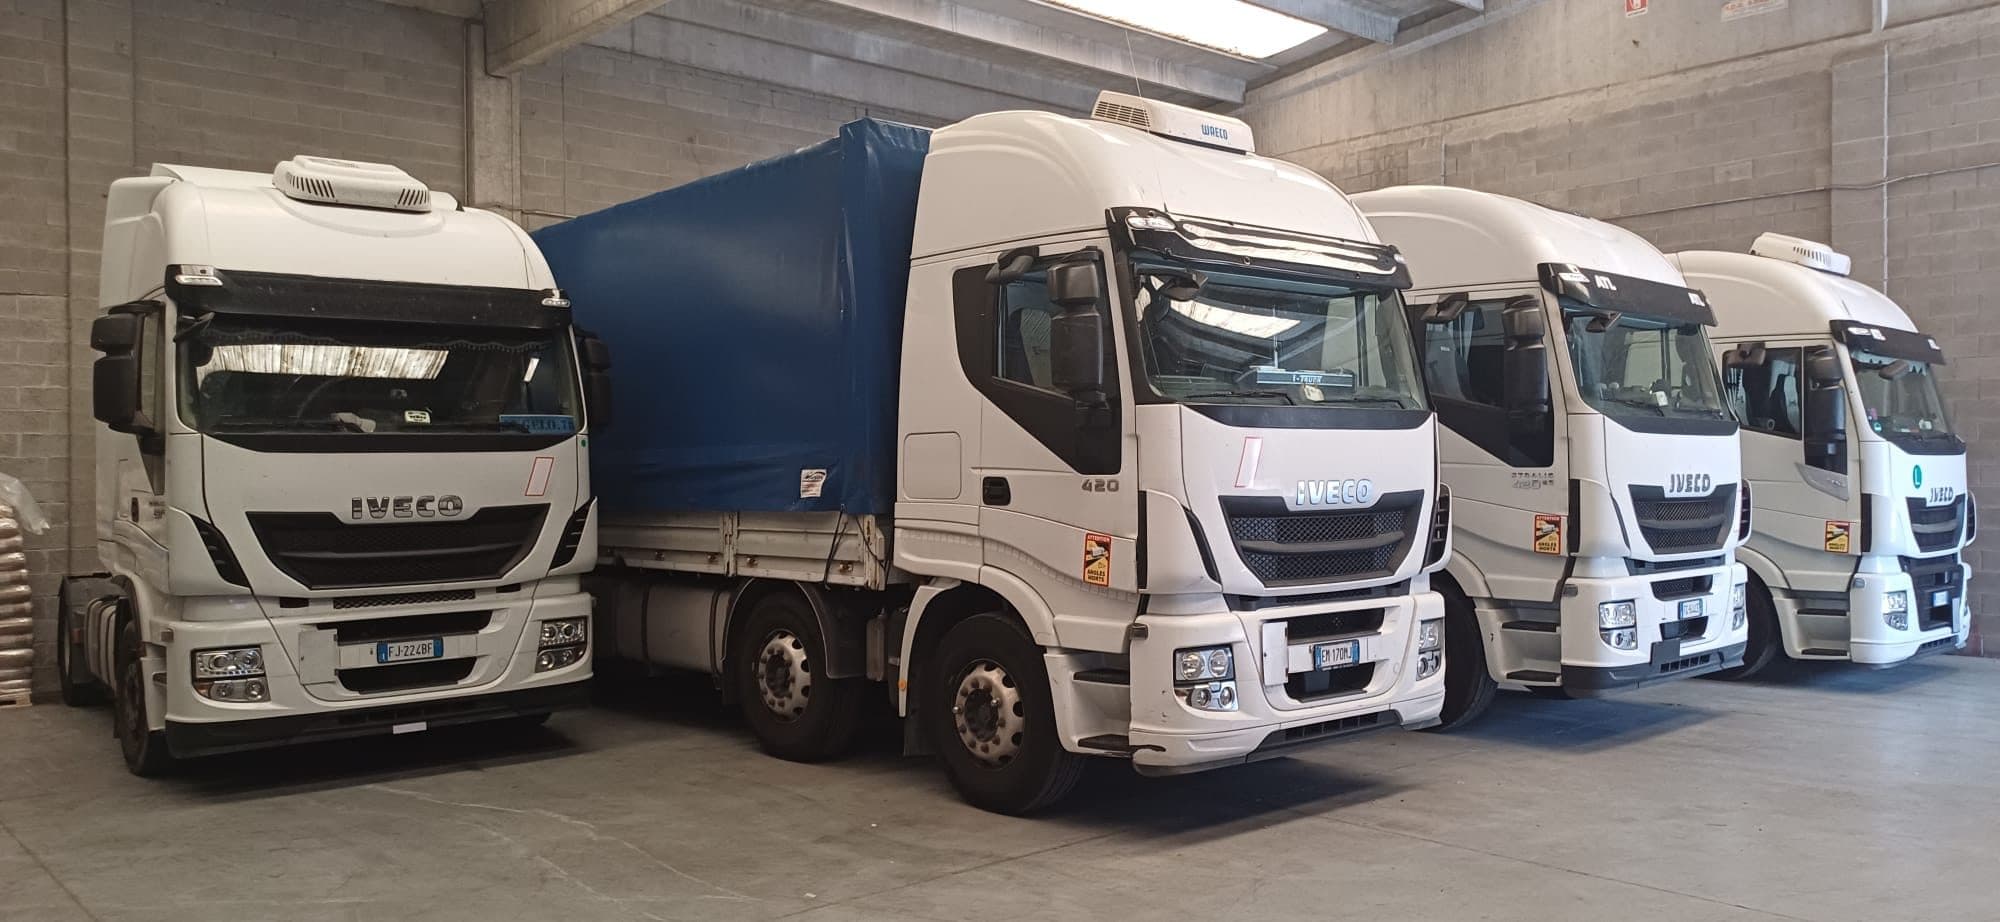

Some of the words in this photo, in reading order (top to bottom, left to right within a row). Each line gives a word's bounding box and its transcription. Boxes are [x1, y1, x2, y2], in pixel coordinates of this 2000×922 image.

[1081, 479, 1120, 492] 420
[1296, 478, 1373, 505] IVECO
[1669, 473, 1711, 493] IVECO
[351, 495, 463, 520] IVECO
